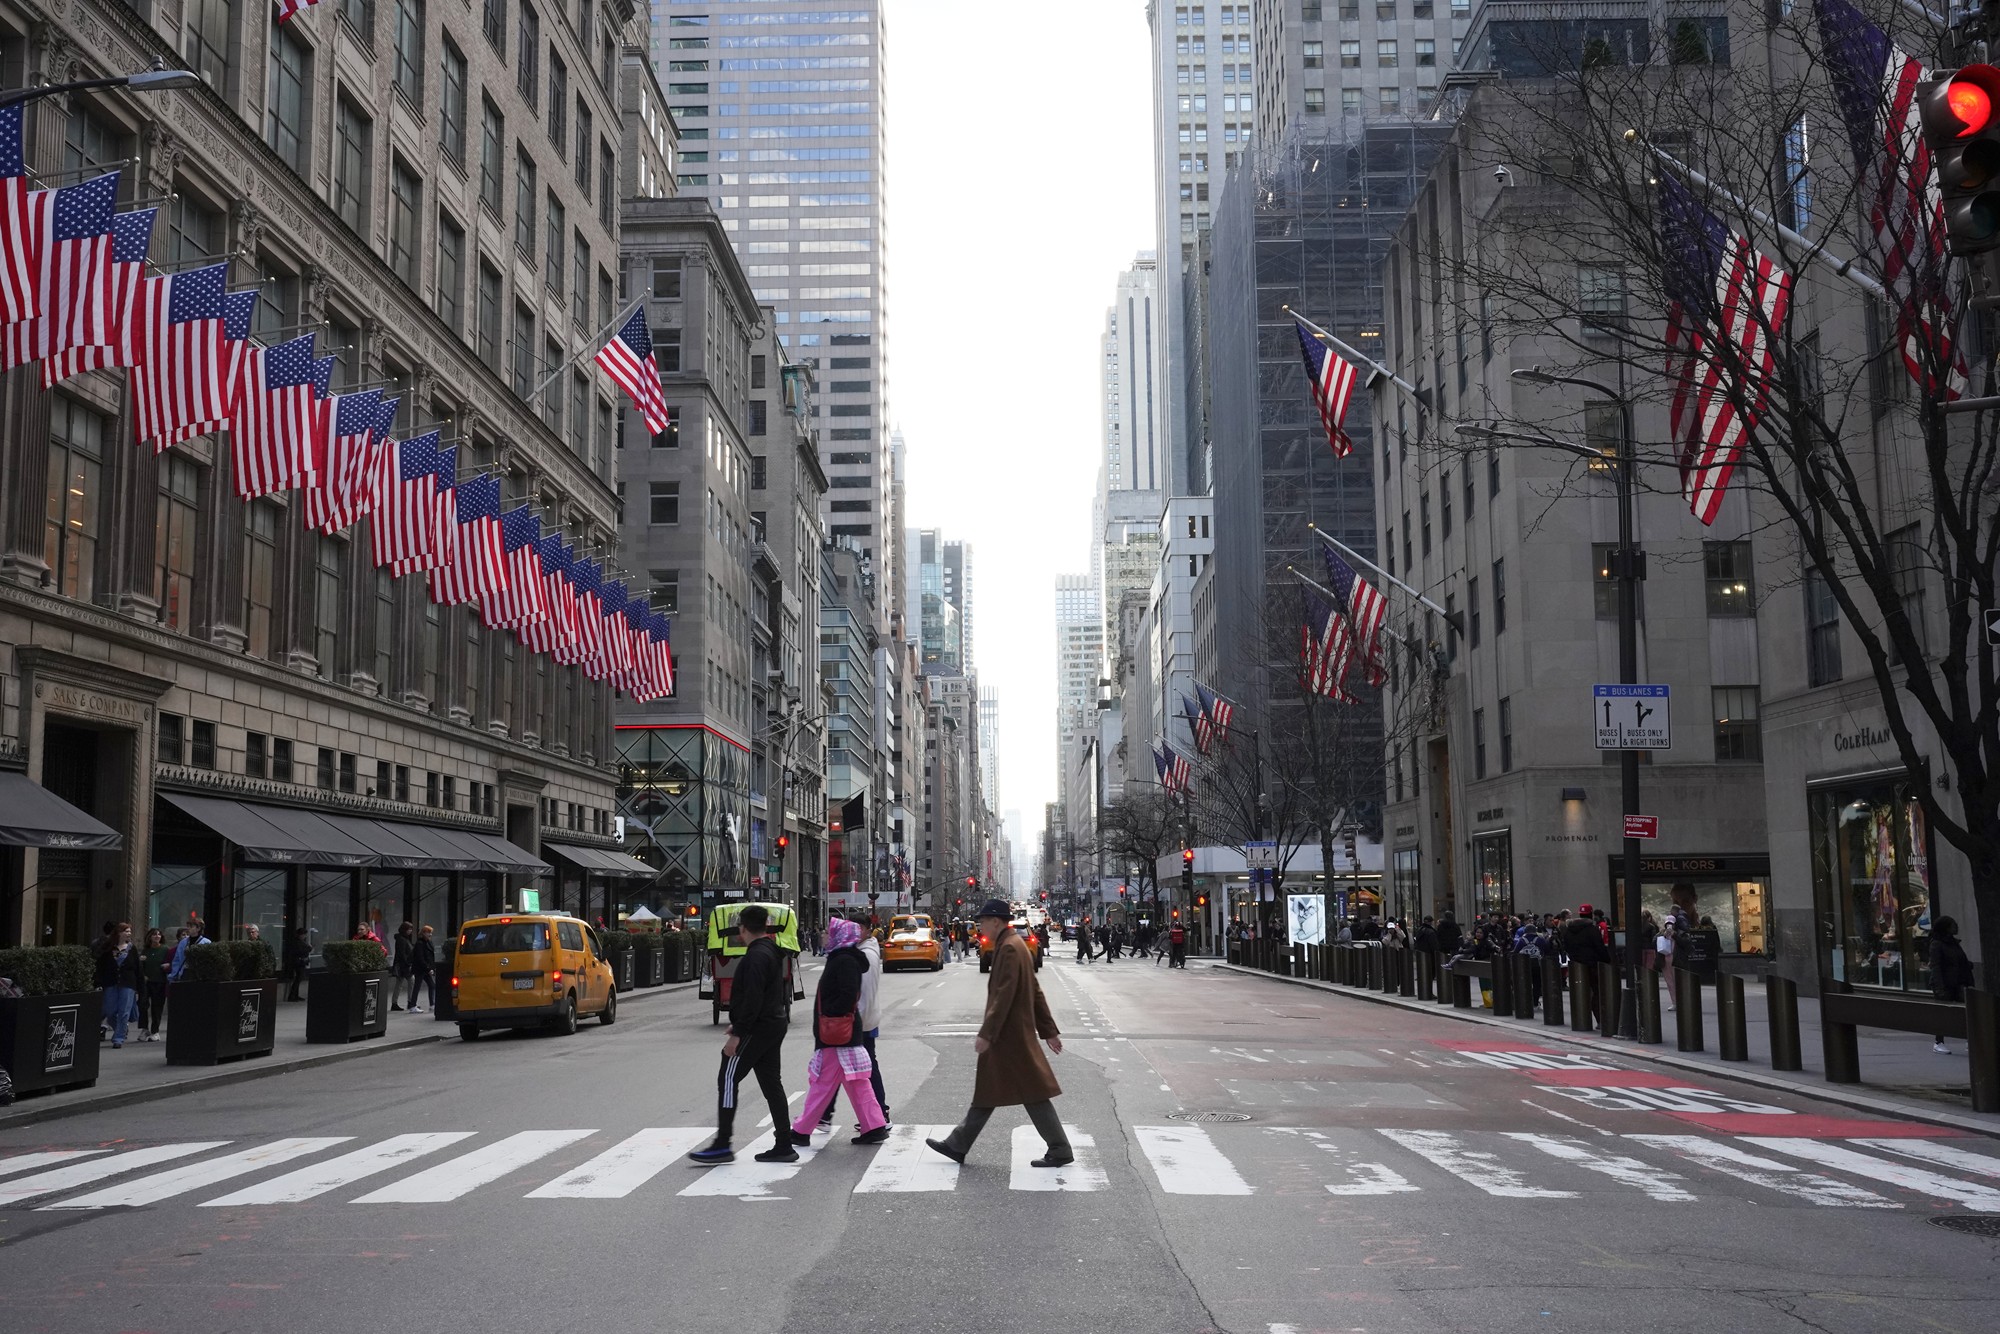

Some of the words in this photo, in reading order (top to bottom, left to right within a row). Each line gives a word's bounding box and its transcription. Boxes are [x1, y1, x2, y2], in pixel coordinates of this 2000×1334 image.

[1612, 687, 1626, 695] BUS
[1629, 687, 1652, 695] LANES
[53, 687, 78, 706] SAKS
[80, 693, 86, 707] &
[89, 695, 137, 721] COMPANY
[1627, 729, 1646, 737] BUSES
[1648, 729, 1662, 737] ONLY
[1601, 738, 1616, 746] ONLY
[1623, 738, 1628, 746] &
[1630, 738, 1647, 746] RIGHT
[1650, 738, 1668, 746] TURNS
[1545, 834, 1598, 842] PROMENADE
[1640, 861, 1678, 871] CHAEL
[1682, 860, 1715, 870] KORS
[724, 890, 744, 898] PUMA
[46, 1042, 72, 1063] Avenue
[1531, 1085, 1797, 1115] BUS
